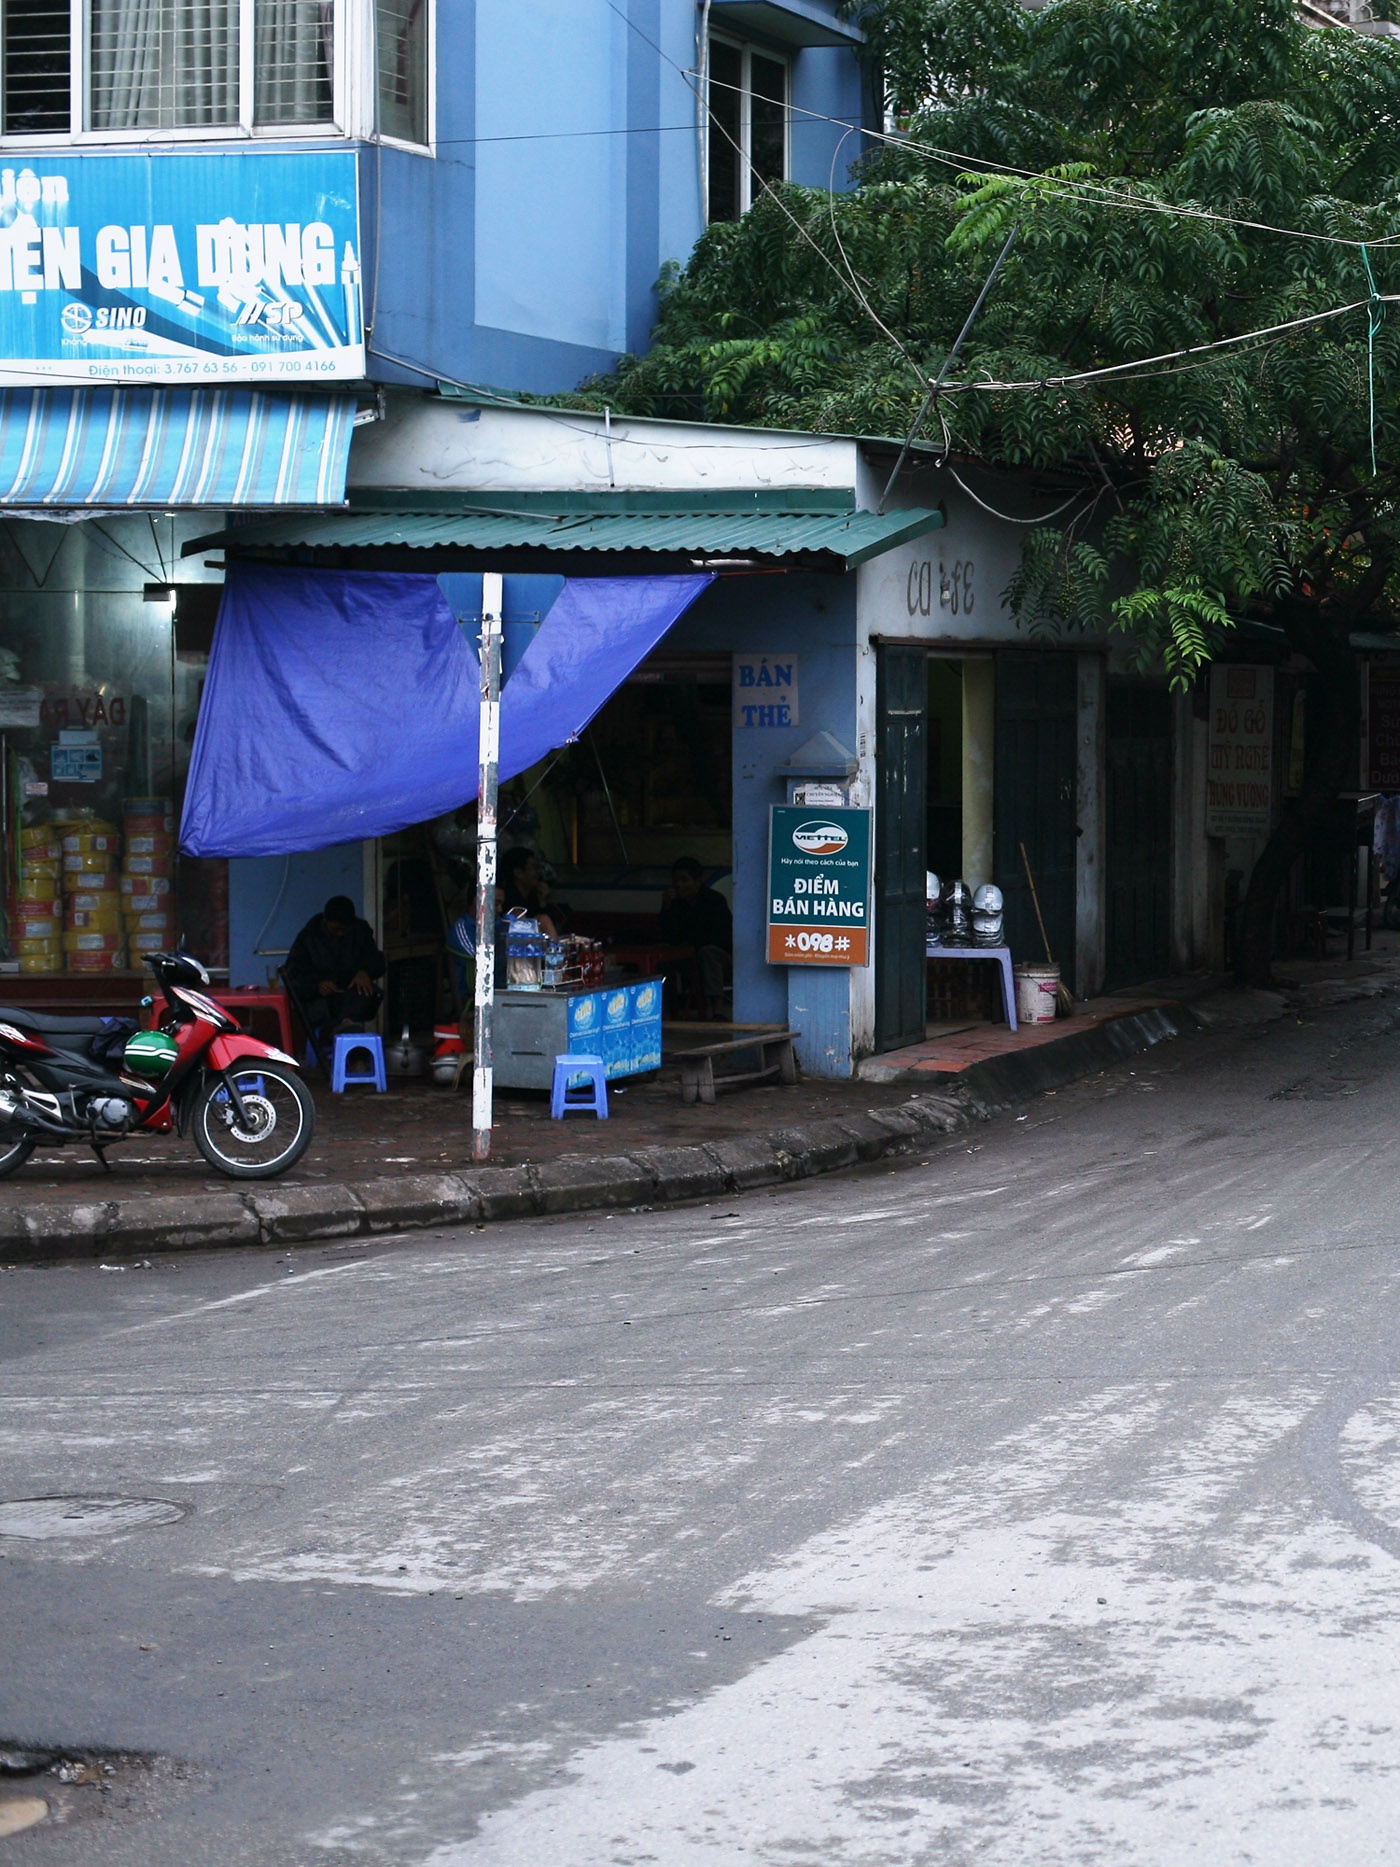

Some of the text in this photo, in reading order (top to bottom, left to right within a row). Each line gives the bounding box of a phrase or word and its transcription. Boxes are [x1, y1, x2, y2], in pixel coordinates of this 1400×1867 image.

[96, 225, 184, 289] GIA
[95, 307, 147, 328] SINO
[89, 360, 336, 377] Điện thoại: 3.767 63 56 091 700 4166
[739, 659, 792, 688] BÁN
[742, 696, 791, 727] THẺ
[795, 834, 846, 842] VIETTEL
[781, 857, 793, 866] Hãy
[804, 858, 819, 866] theo
[819, 858, 834, 866] cách
[835, 858, 846, 866] của
[847, 859, 859, 868] bạn
[793, 873, 839, 895] ĐIỂM
[772, 896, 864, 918] BÁN HÀNG
